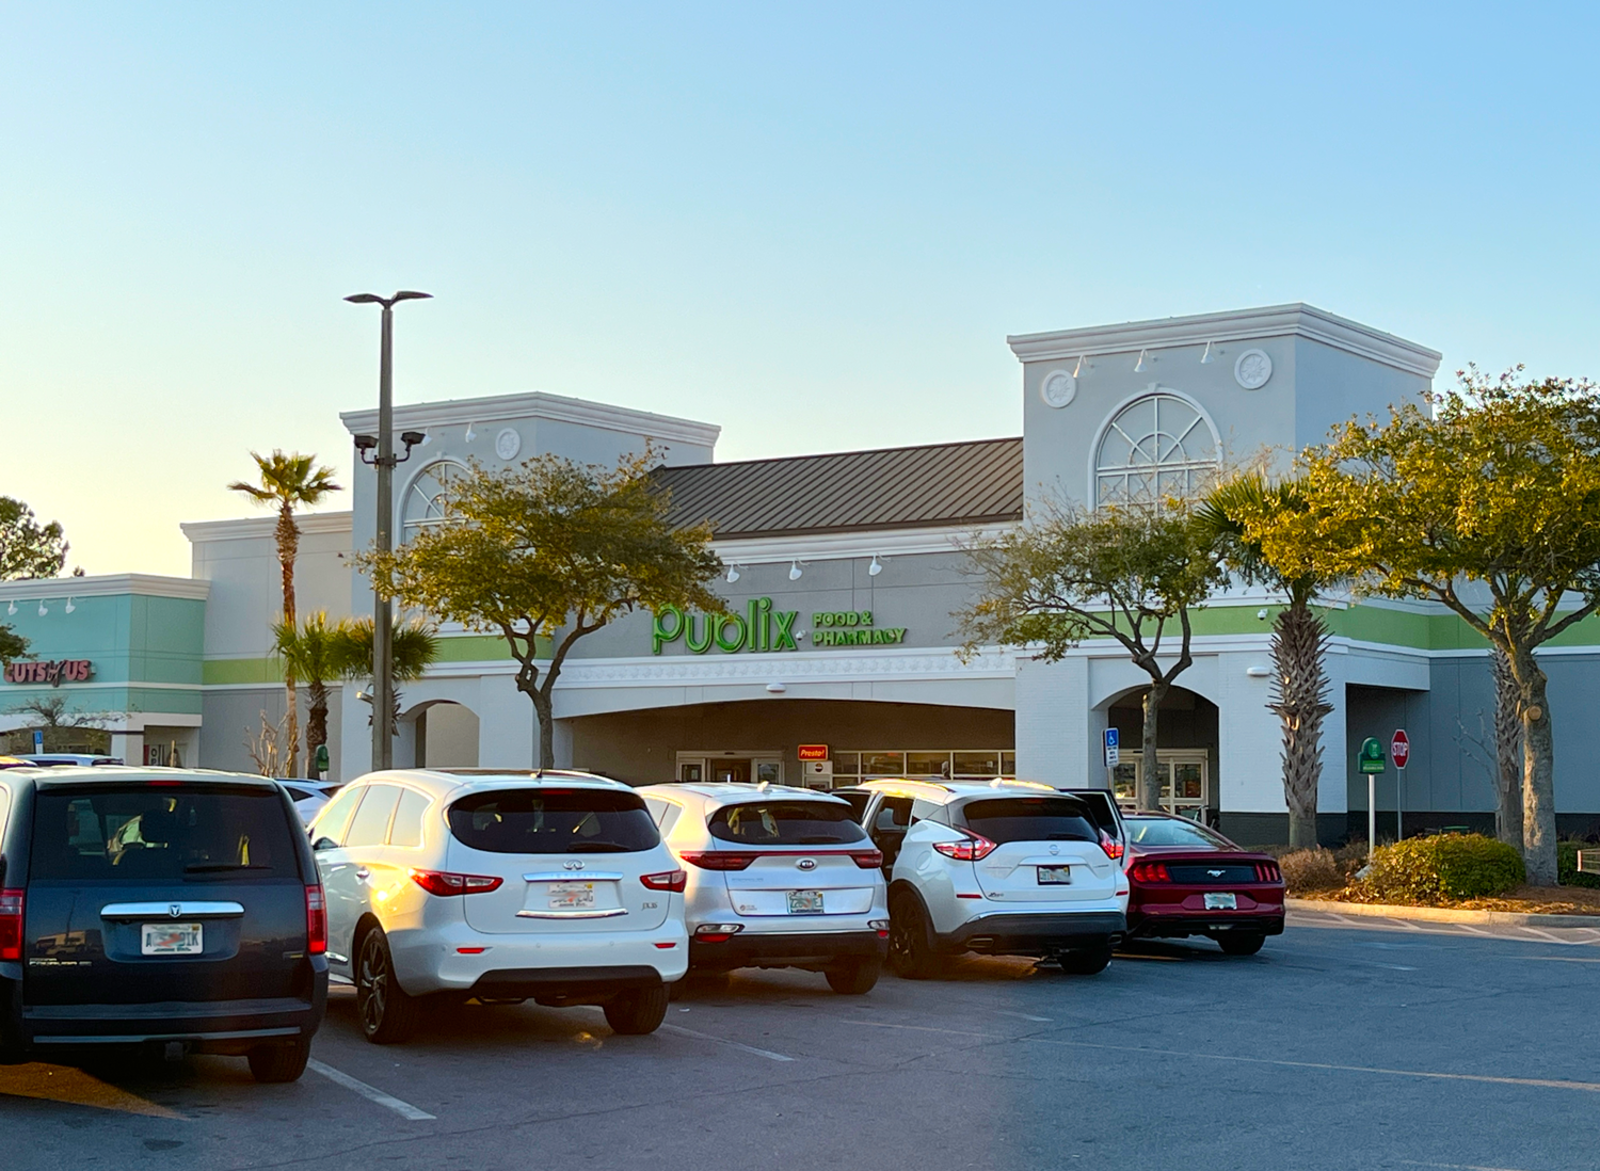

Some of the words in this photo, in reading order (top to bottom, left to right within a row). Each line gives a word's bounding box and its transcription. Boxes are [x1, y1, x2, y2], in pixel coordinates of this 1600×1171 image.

[652, 597, 798, 655] Publix
[812, 611, 859, 628] FOOD
[861, 610, 872, 626] &
[812, 628, 907, 647] PHARMACY
[4, 661, 48, 684] CUTS
[800, 749, 825, 757] Presto!
[1393, 742, 1408, 756] STOP
